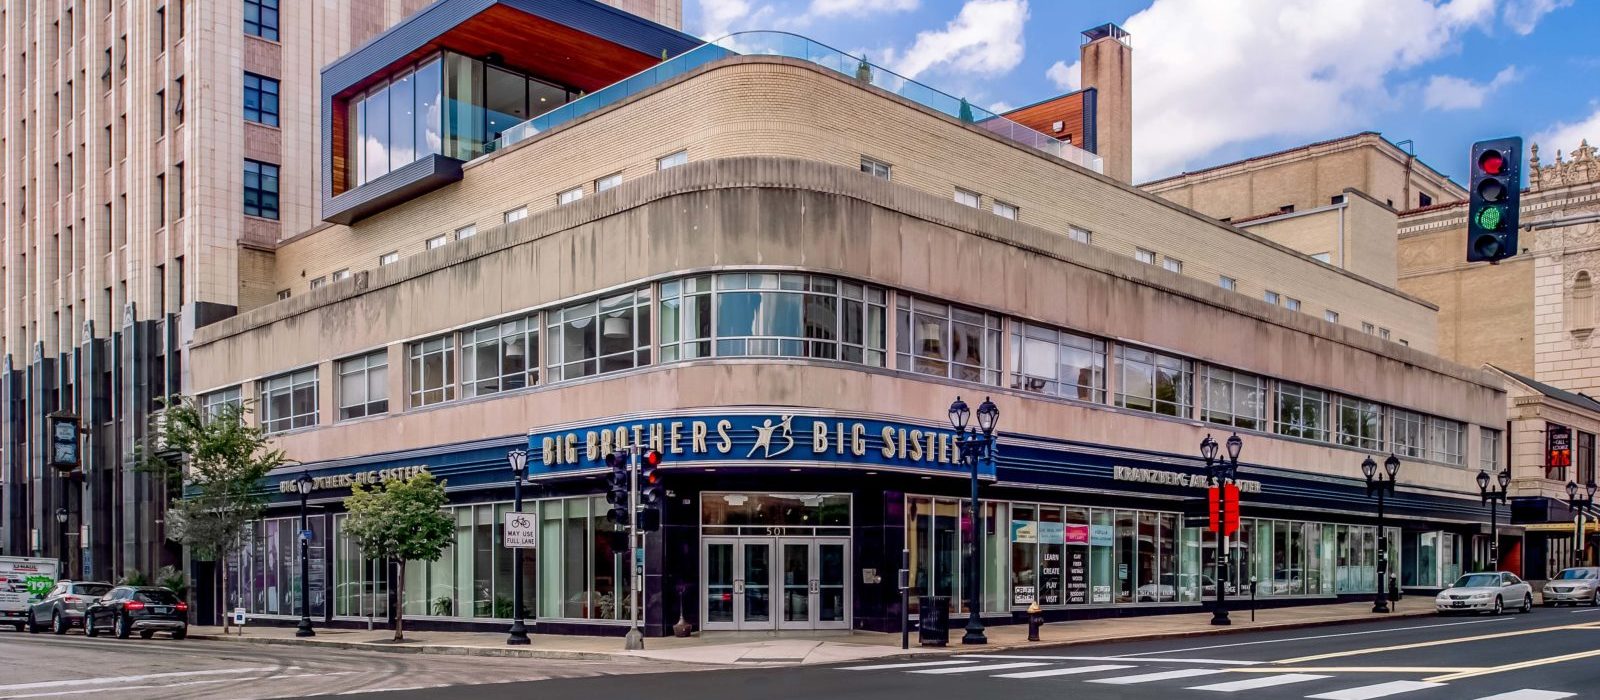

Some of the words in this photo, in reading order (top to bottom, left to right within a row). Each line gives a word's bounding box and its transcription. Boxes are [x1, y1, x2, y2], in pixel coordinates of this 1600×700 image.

[542, 433, 578, 466] BIG
[586, 419, 732, 461] BROTHERS
[813, 421, 866, 456] BIG
[882, 426, 961, 464] SISTE
[279, 480, 297, 493] BIG
[311, 473, 354, 490] OTHERS
[355, 471, 378, 484] BIG
[1113, 465, 1189, 487] KRANZBERG
[1189, 474, 1219, 489] ARS
[1223, 477, 1261, 493] NTER
[766, 527, 786, 536] 501
[1043, 567, 1060, 575] CREATE
[1046, 595, 1058, 603] VISIT
